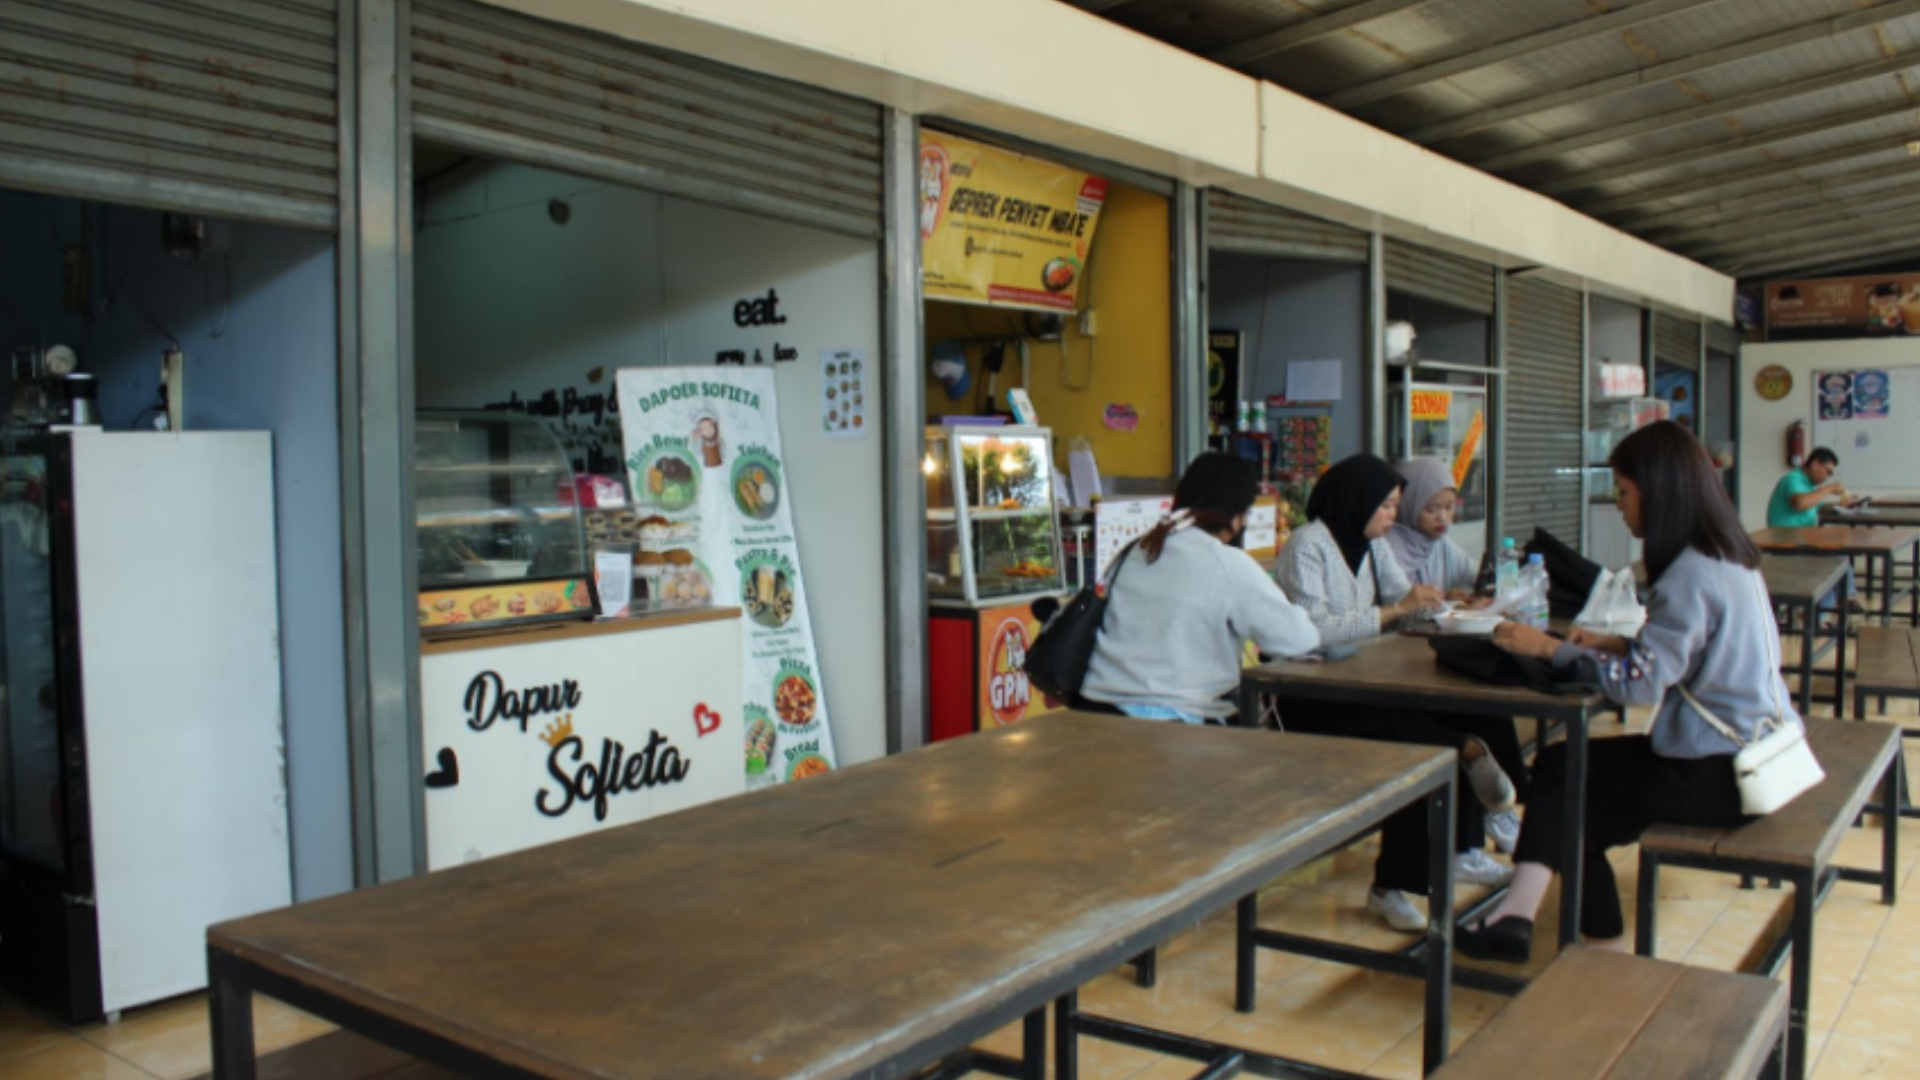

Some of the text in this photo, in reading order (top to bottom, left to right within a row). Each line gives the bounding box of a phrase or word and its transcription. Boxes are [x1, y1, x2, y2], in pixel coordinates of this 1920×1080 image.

[733, 287, 787, 327] eat.
[638, 382, 699, 413] DAPOER
[701, 381, 760, 410] SOFIETA
[779, 656, 810, 677] Pizza
[464, 669, 582, 733] Dapur
[989, 671, 1030, 711] GPM
[783, 738, 819, 762] Bread
